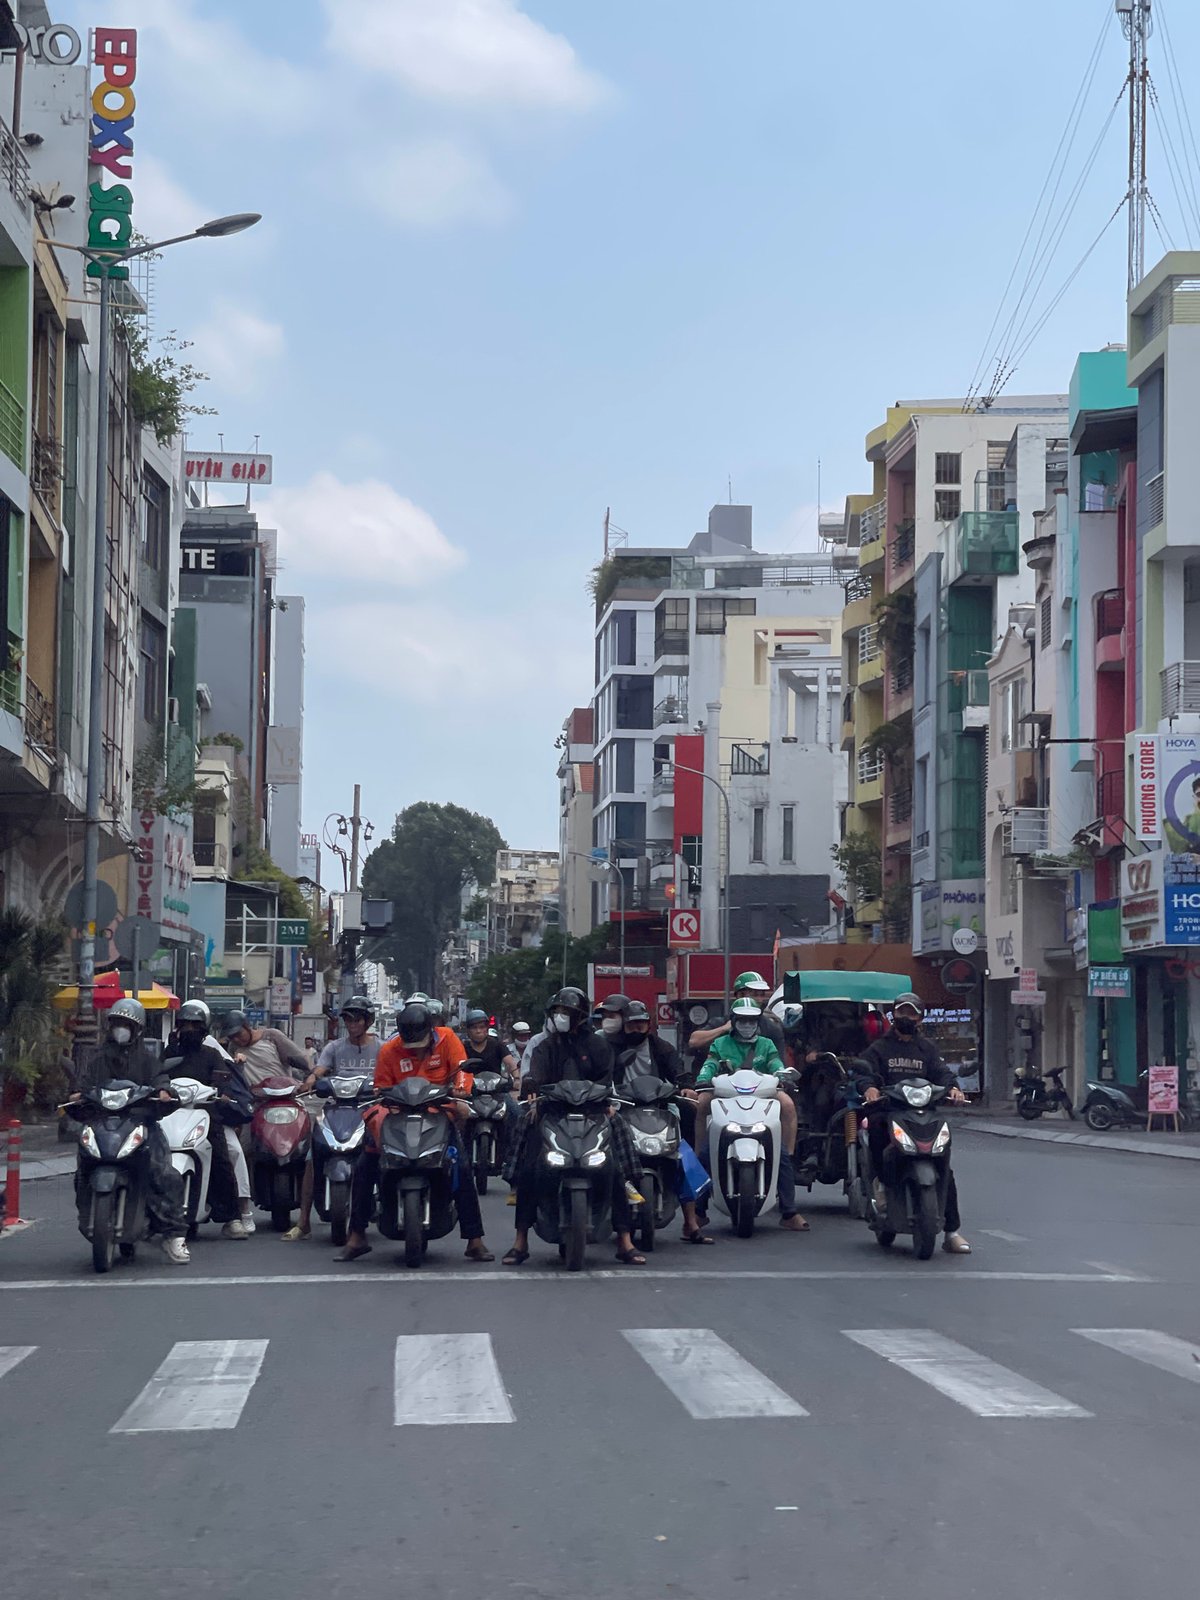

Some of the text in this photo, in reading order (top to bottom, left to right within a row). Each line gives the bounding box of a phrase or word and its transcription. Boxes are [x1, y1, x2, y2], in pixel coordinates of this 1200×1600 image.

[90, 27, 137, 180] EPOXY
[231, 458, 266, 480] GIÁP
[1166, 739, 1196, 747] HOYA
[1140, 741, 1157, 834] PHƯƠNG STORE
[281, 925, 305, 935] 2M2
[888, 1057, 923, 1069] SUMMIT
